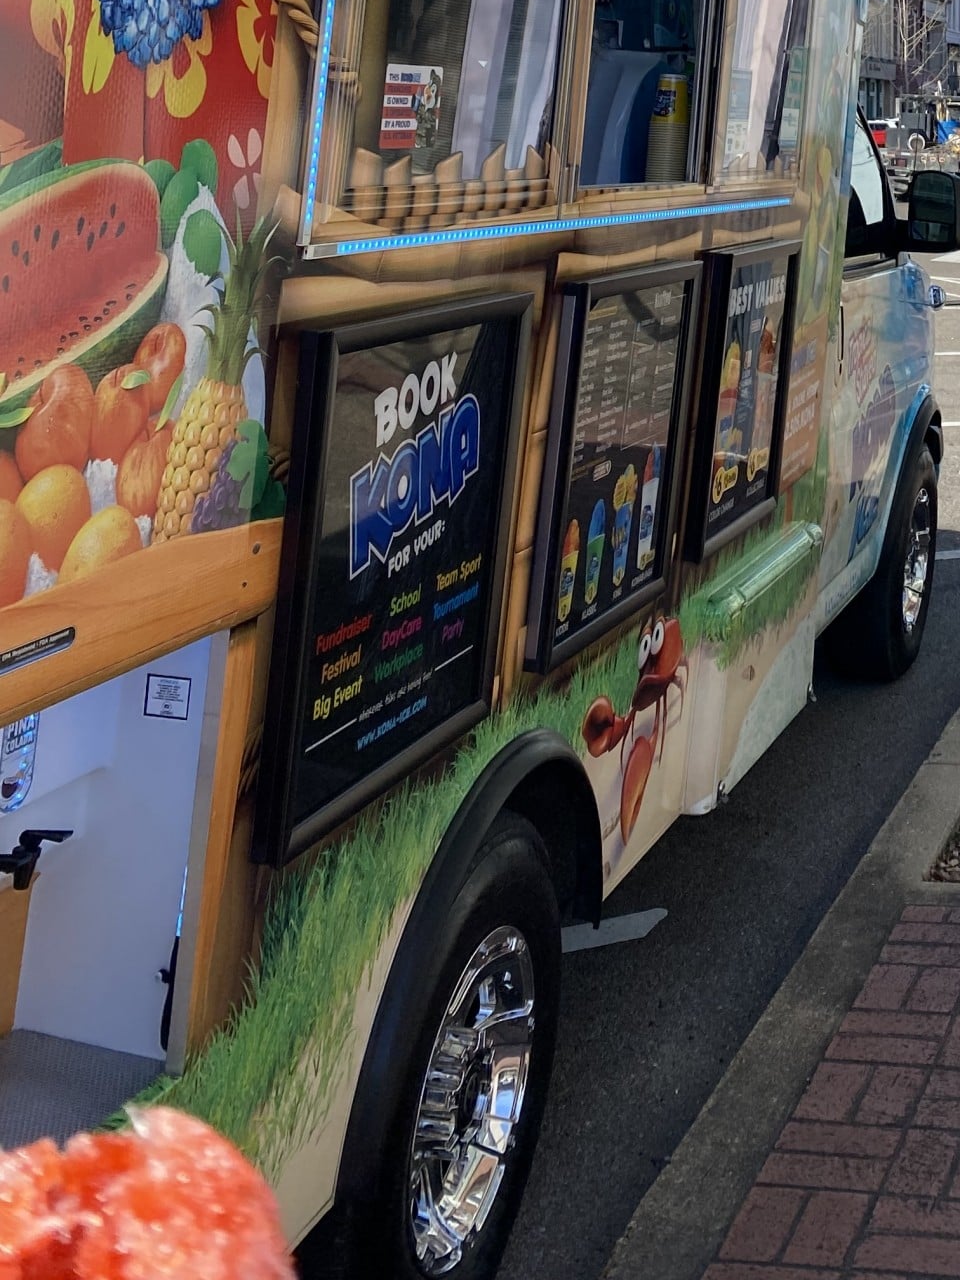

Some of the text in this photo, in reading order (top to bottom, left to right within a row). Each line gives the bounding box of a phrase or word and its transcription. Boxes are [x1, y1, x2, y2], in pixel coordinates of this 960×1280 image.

[395, 120, 411, 128] PROUD
[729, 275, 786, 318] BEST VALUES
[374, 351, 458, 448] BOOK
[350, 393, 480, 580] KONA
[388, 520, 446, 578] FOR YOUR:
[436, 553, 482, 592] Team Sport
[390, 583, 422, 617] School
[433, 581, 479, 620] Tournament
[316, 613, 373, 656] Fundraiser
[381, 616, 422, 651] DayCare
[441, 618, 464, 646] Party
[320, 644, 362, 684] Festival
[375, 642, 424, 684] Workplace
[313, 674, 363, 720] Big Event
